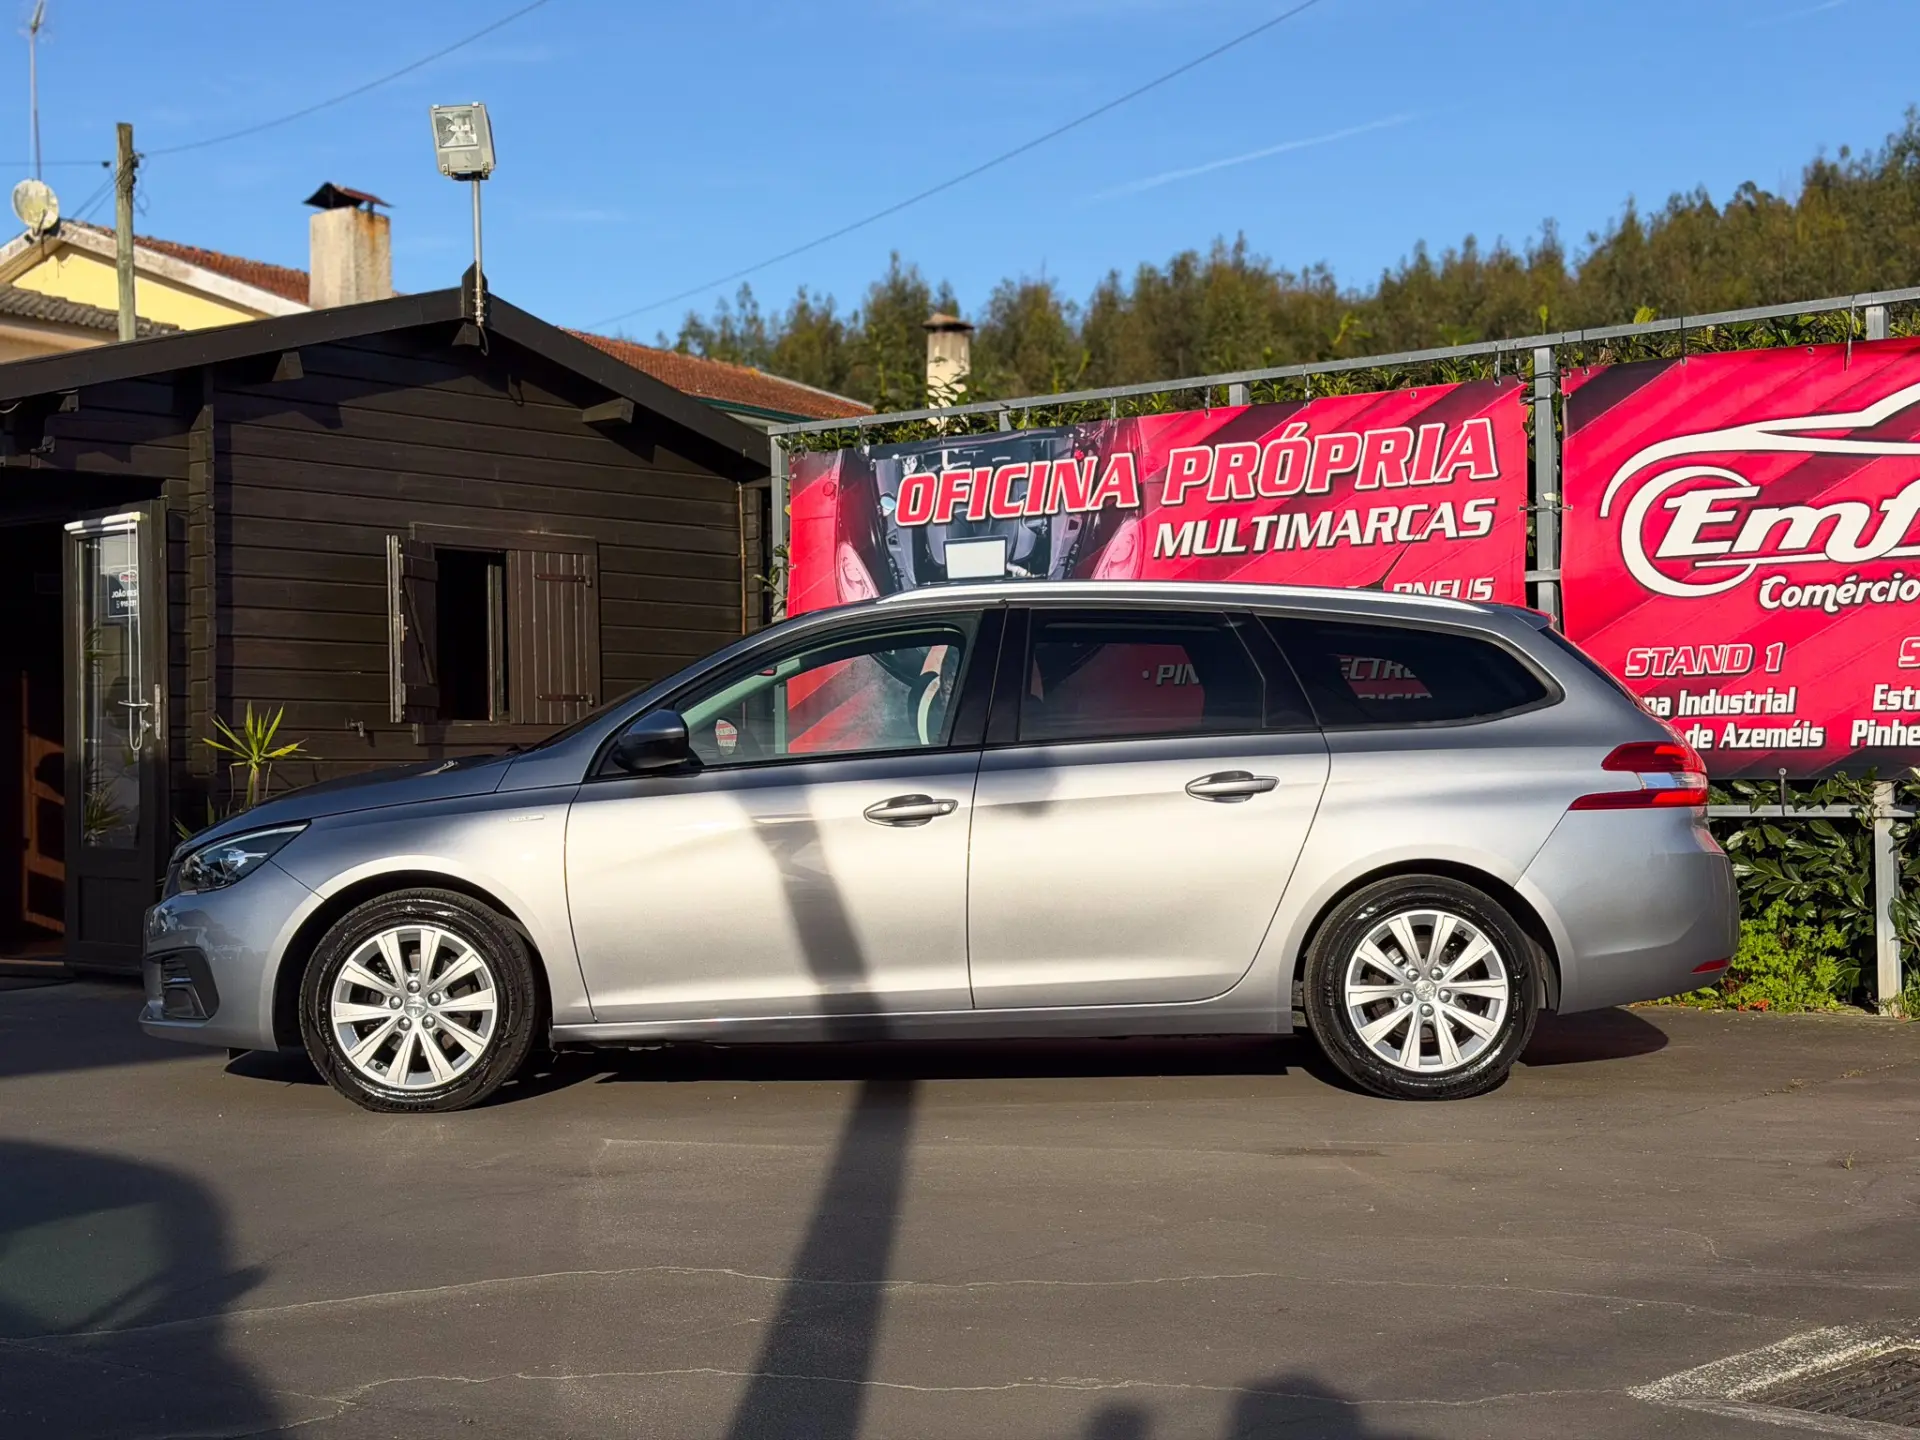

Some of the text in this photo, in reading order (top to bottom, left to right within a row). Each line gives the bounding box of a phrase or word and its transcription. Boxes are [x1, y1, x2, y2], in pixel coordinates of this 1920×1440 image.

[895, 417, 1499, 526] OFICINA PRÓPRIA
[1153, 498, 1497, 559] MULTIMARCAS
[1759, 572, 1920, 613] Comércio
[1625, 642, 1785, 677] STAND 1
[1643, 686, 1796, 716] na Industrial
[1685, 719, 1824, 749] de Azeméis
[1850, 719, 1920, 747] Pinhe
